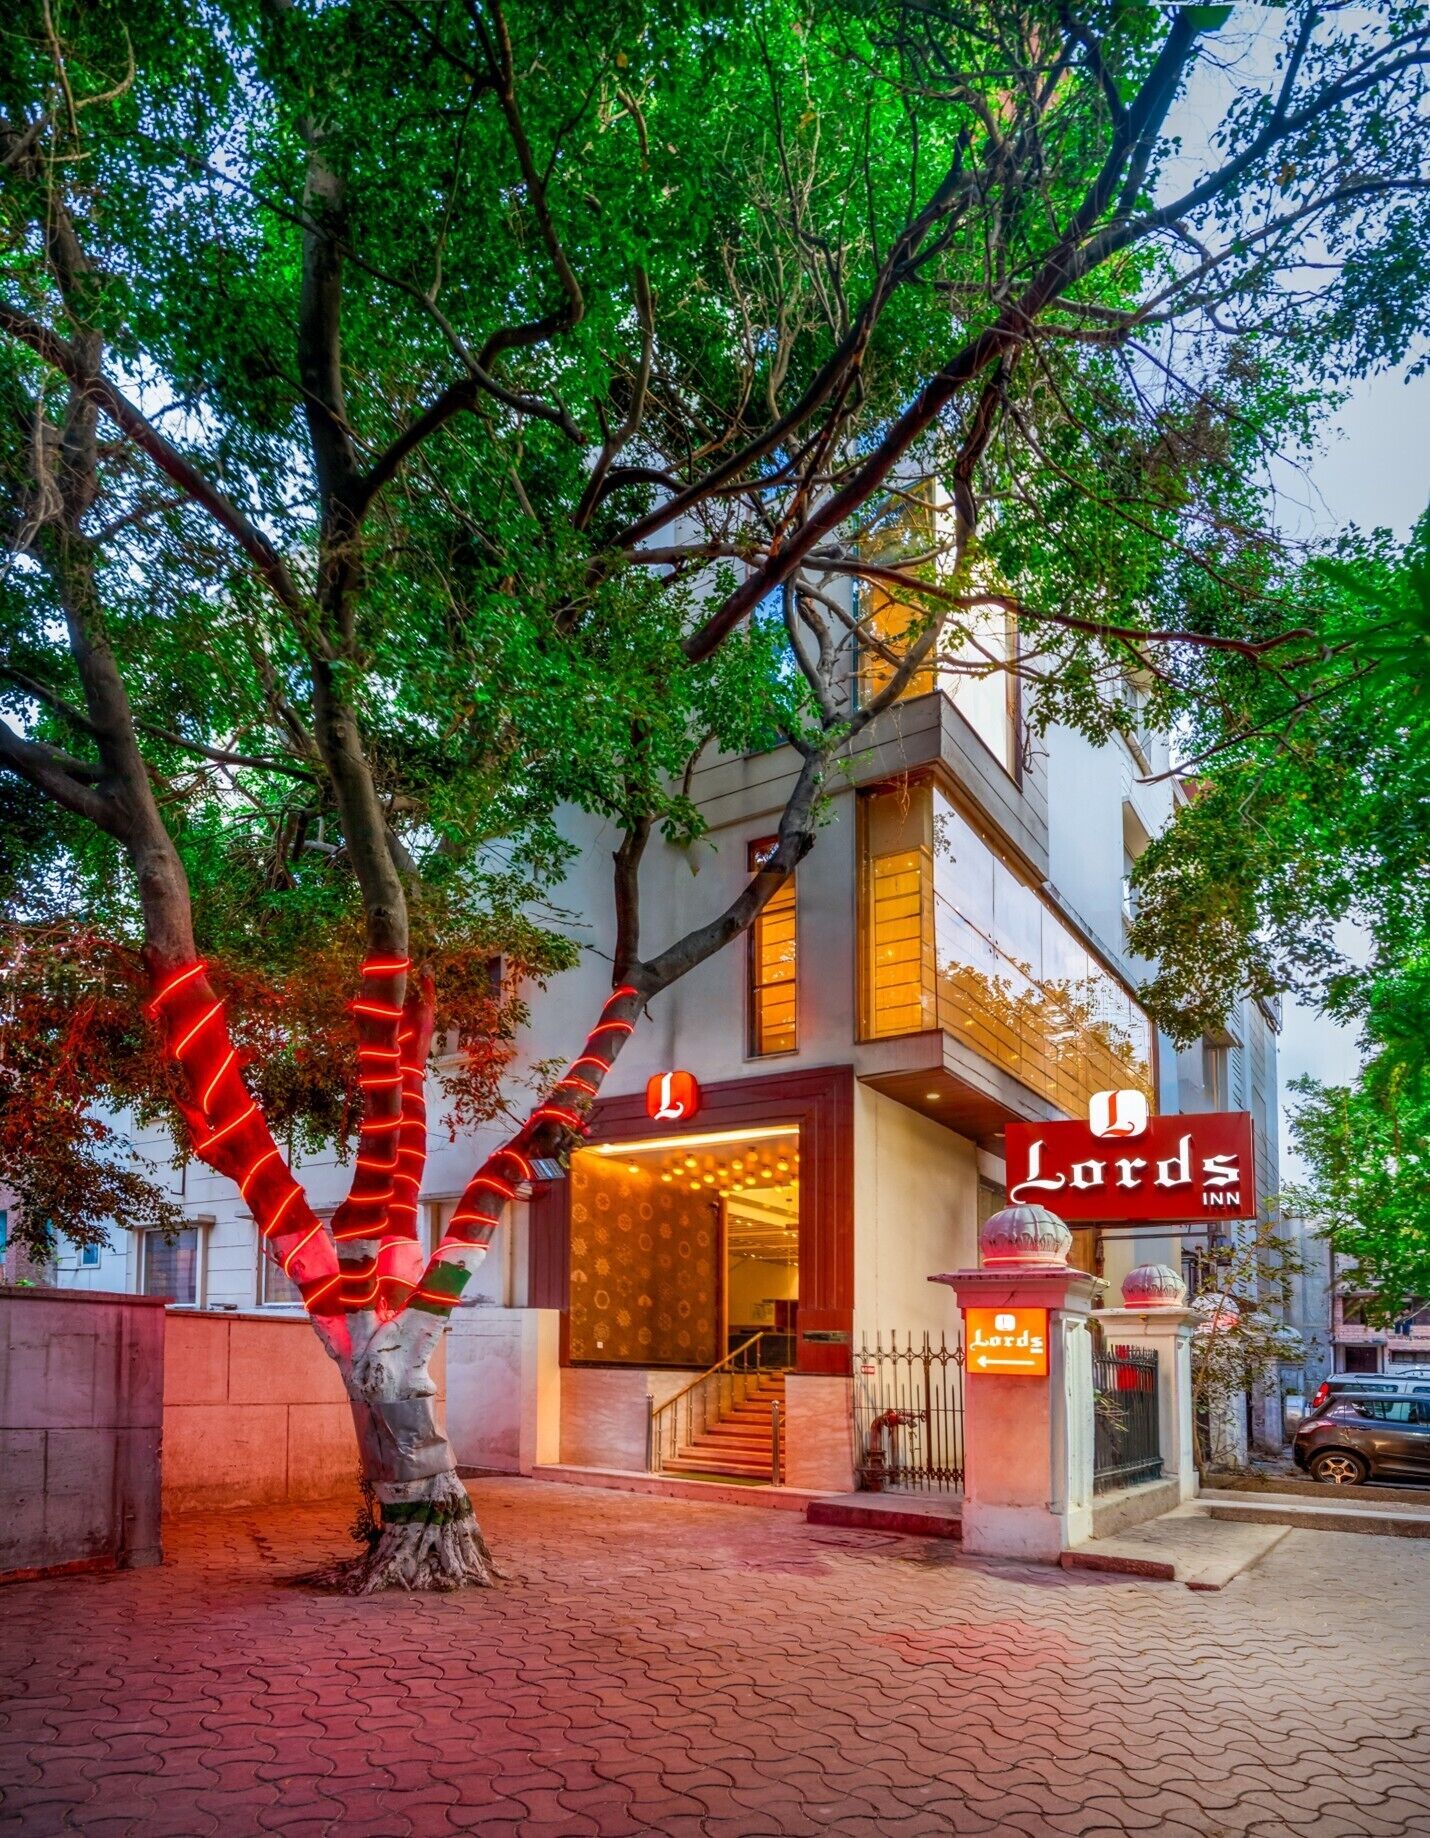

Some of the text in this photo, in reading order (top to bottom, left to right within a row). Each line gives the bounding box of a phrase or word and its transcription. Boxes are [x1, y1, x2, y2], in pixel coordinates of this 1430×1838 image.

[654, 1072, 684, 1120] L
[1102, 1091, 1134, 1135] L
[1010, 1135, 1240, 1204] Lords
[1203, 1192, 1240, 1205] INN
[969, 1328, 1044, 1351] Lords
